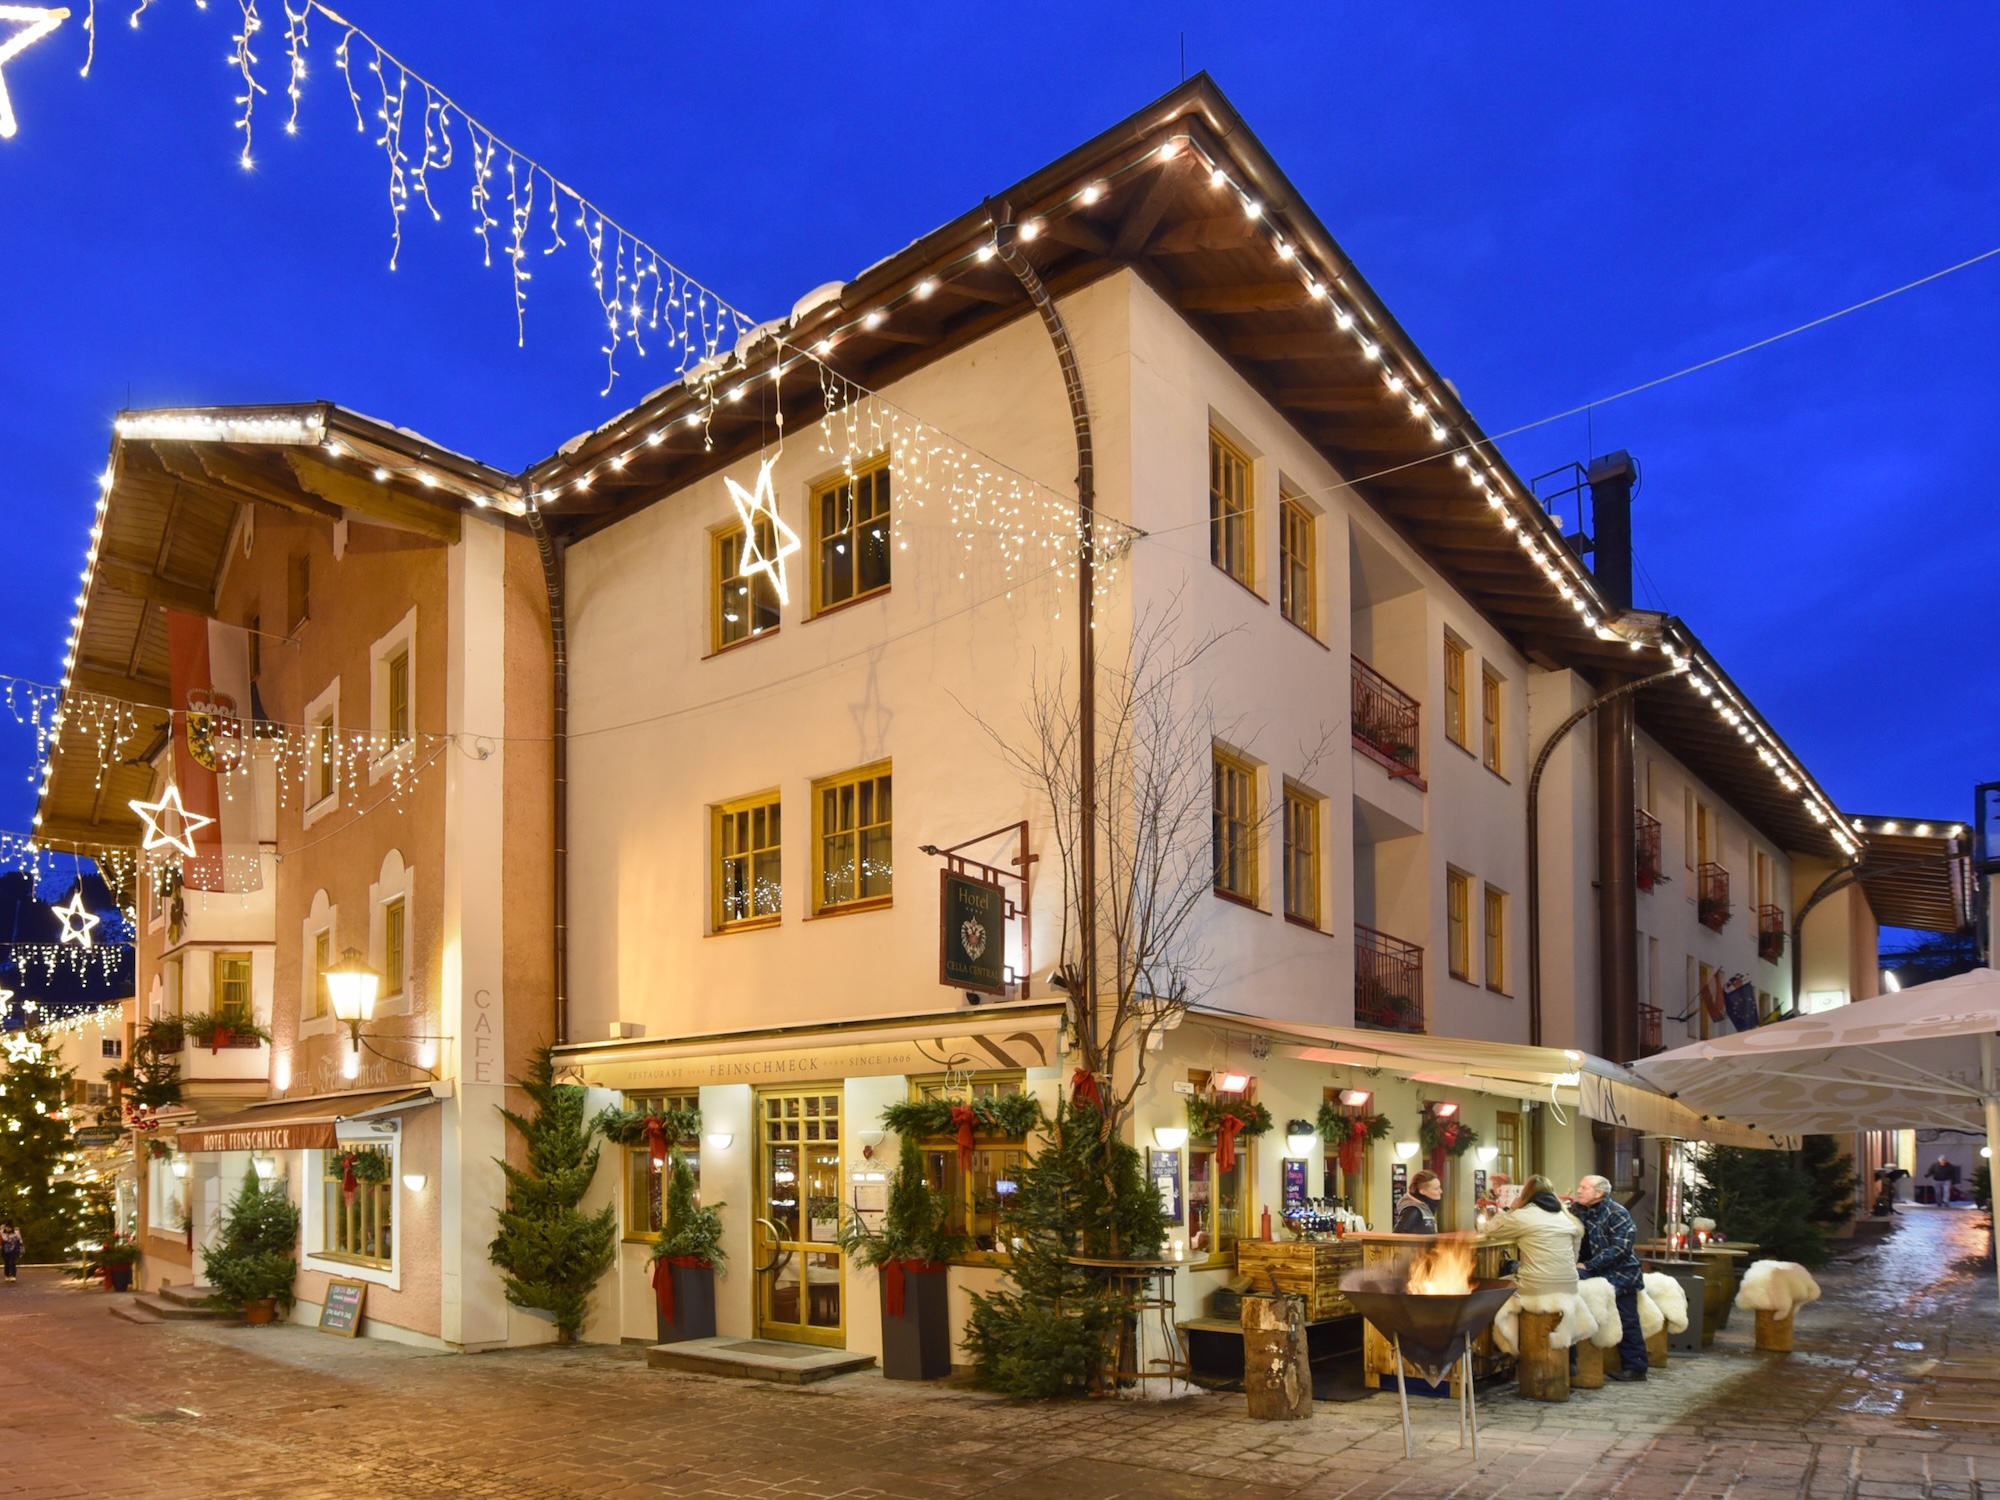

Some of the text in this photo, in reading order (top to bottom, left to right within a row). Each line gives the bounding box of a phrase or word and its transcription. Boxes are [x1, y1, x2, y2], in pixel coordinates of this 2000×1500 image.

[958, 887, 989, 910] Hotel
[947, 960, 999, 979] CELLA CENTRAL
[474, 989, 494, 1083] CAFÉ
[628, 1054, 912, 1080] RESTAURANT FEINSCHMECK SINCE 1606
[203, 1129, 290, 1151] HOTEL FEINSCHMECK
